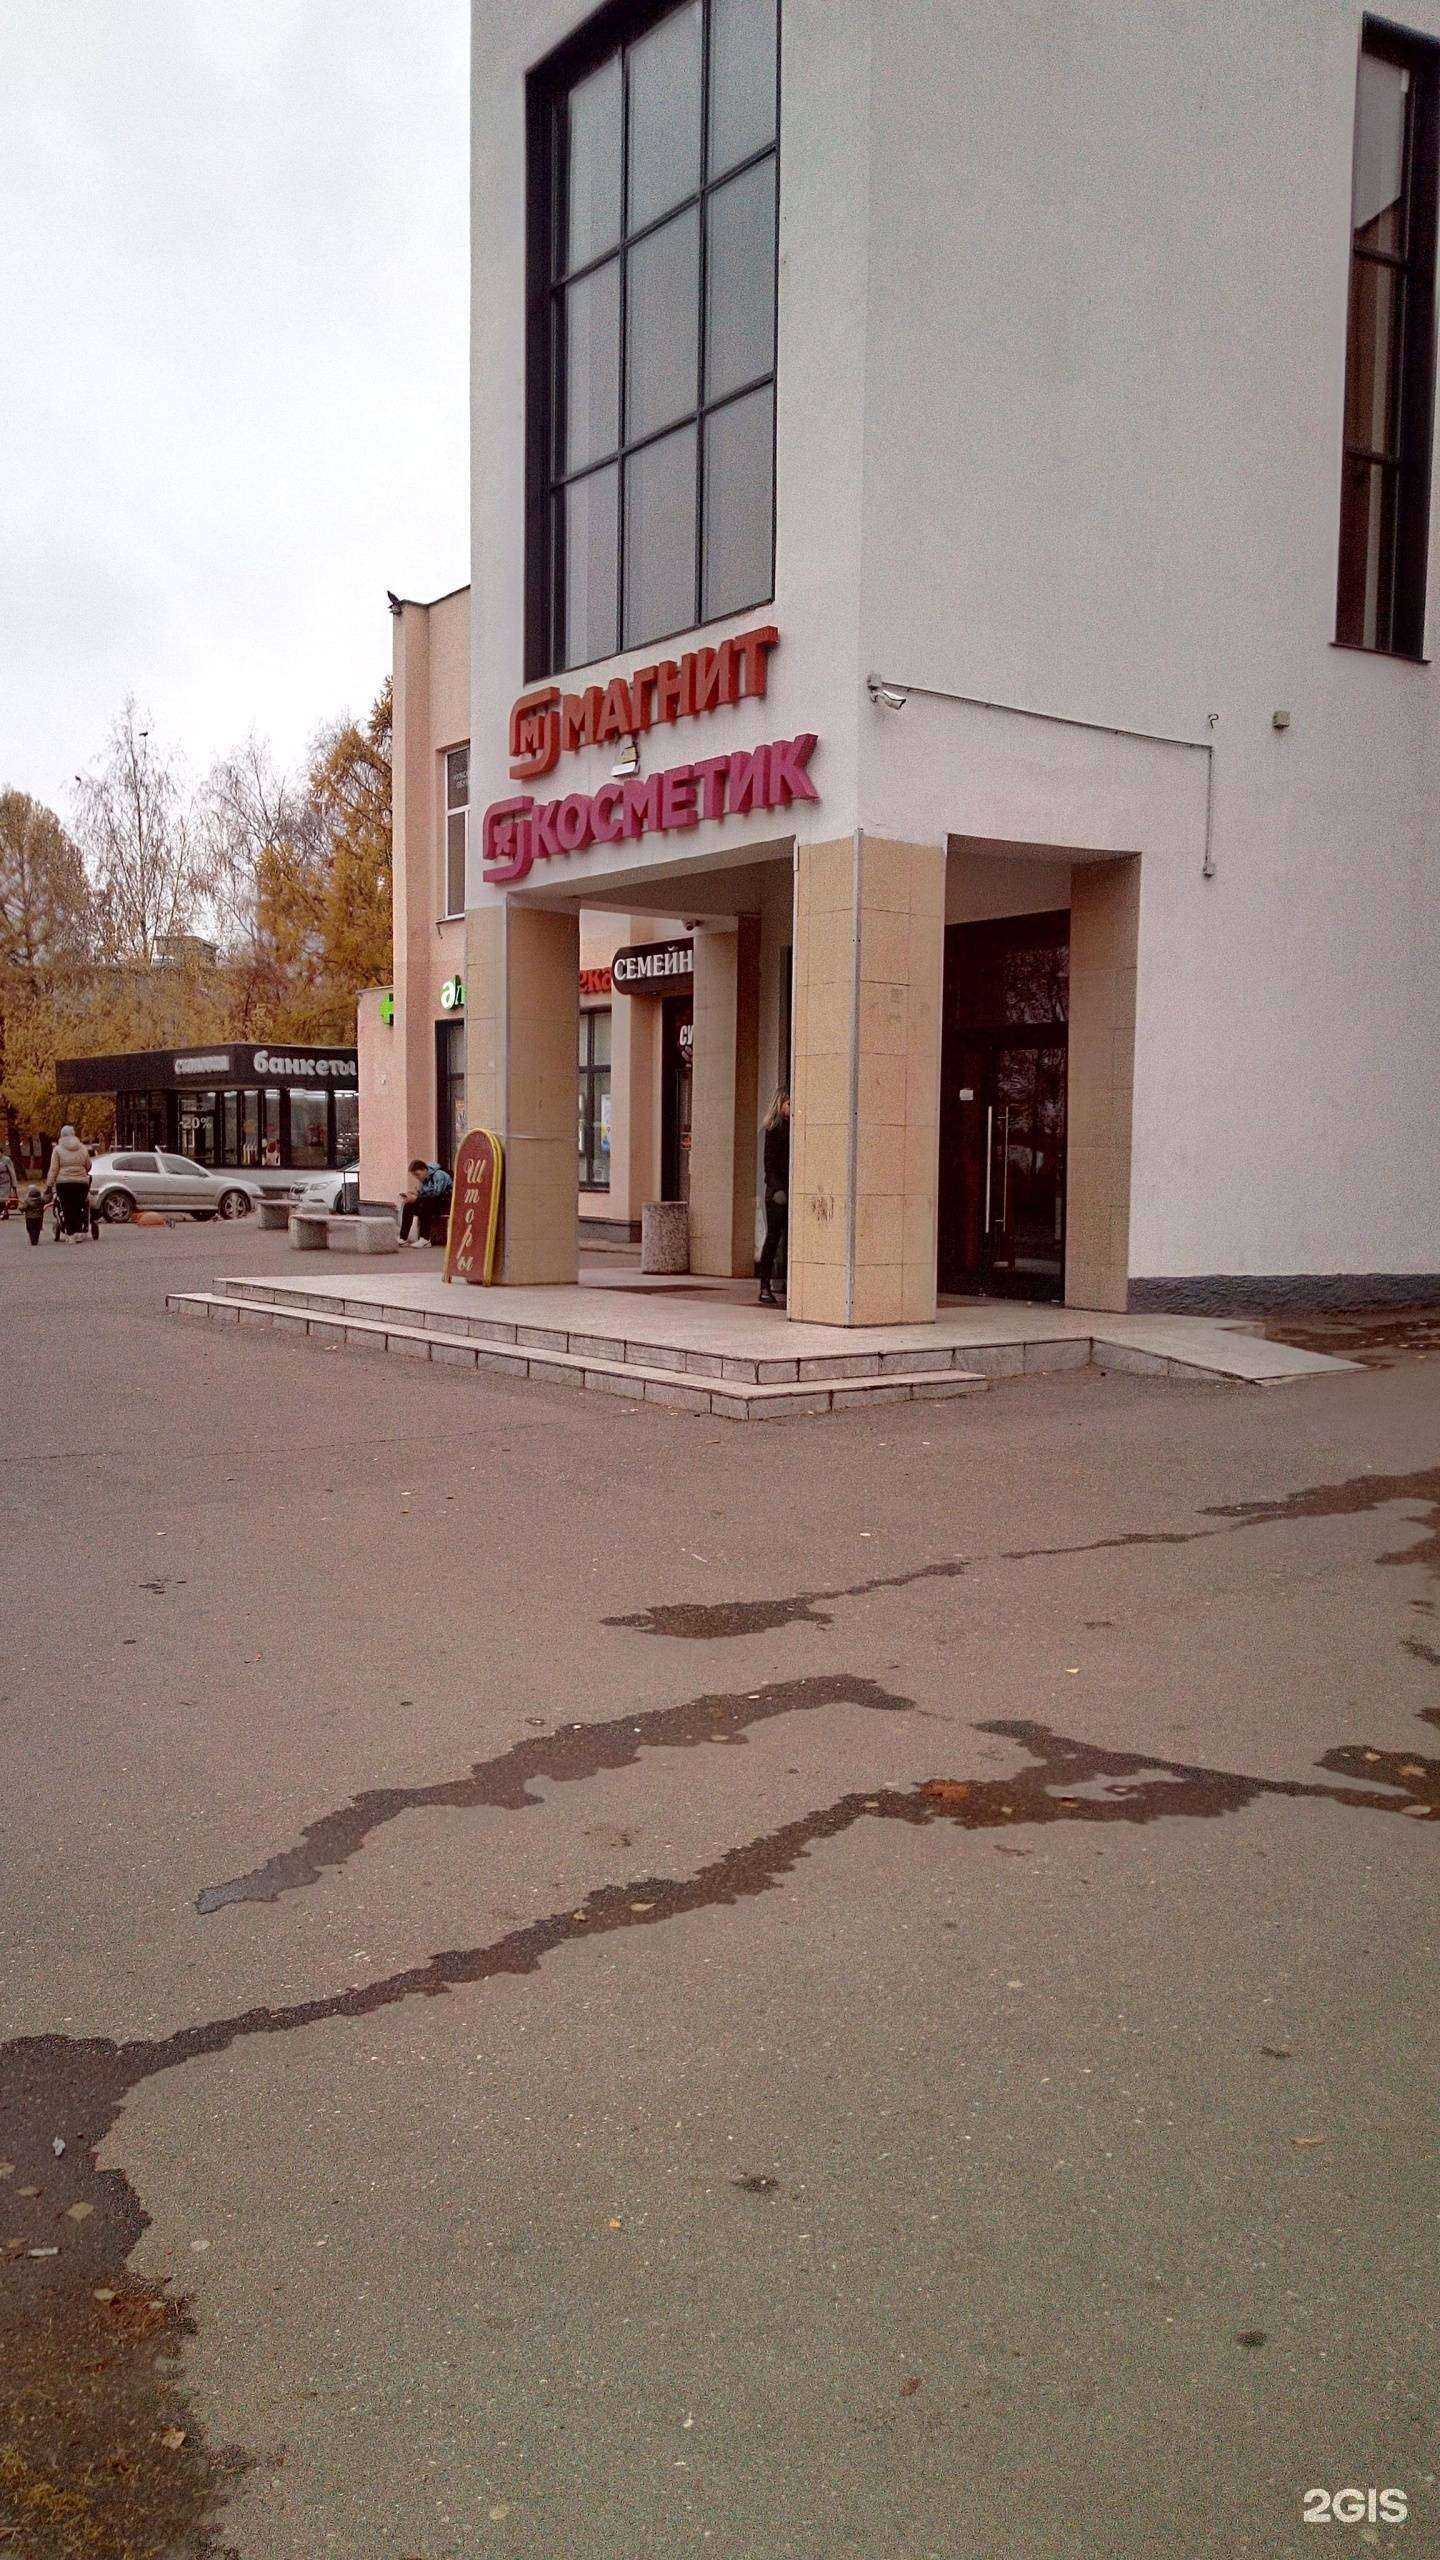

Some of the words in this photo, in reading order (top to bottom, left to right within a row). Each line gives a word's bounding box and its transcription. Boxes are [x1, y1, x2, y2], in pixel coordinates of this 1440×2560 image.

[562, 625, 779, 752] МАГНИТ
[531, 733, 820, 859] КОСМЕТИК
[613, 945, 694, 981] СЕМЕЙН
